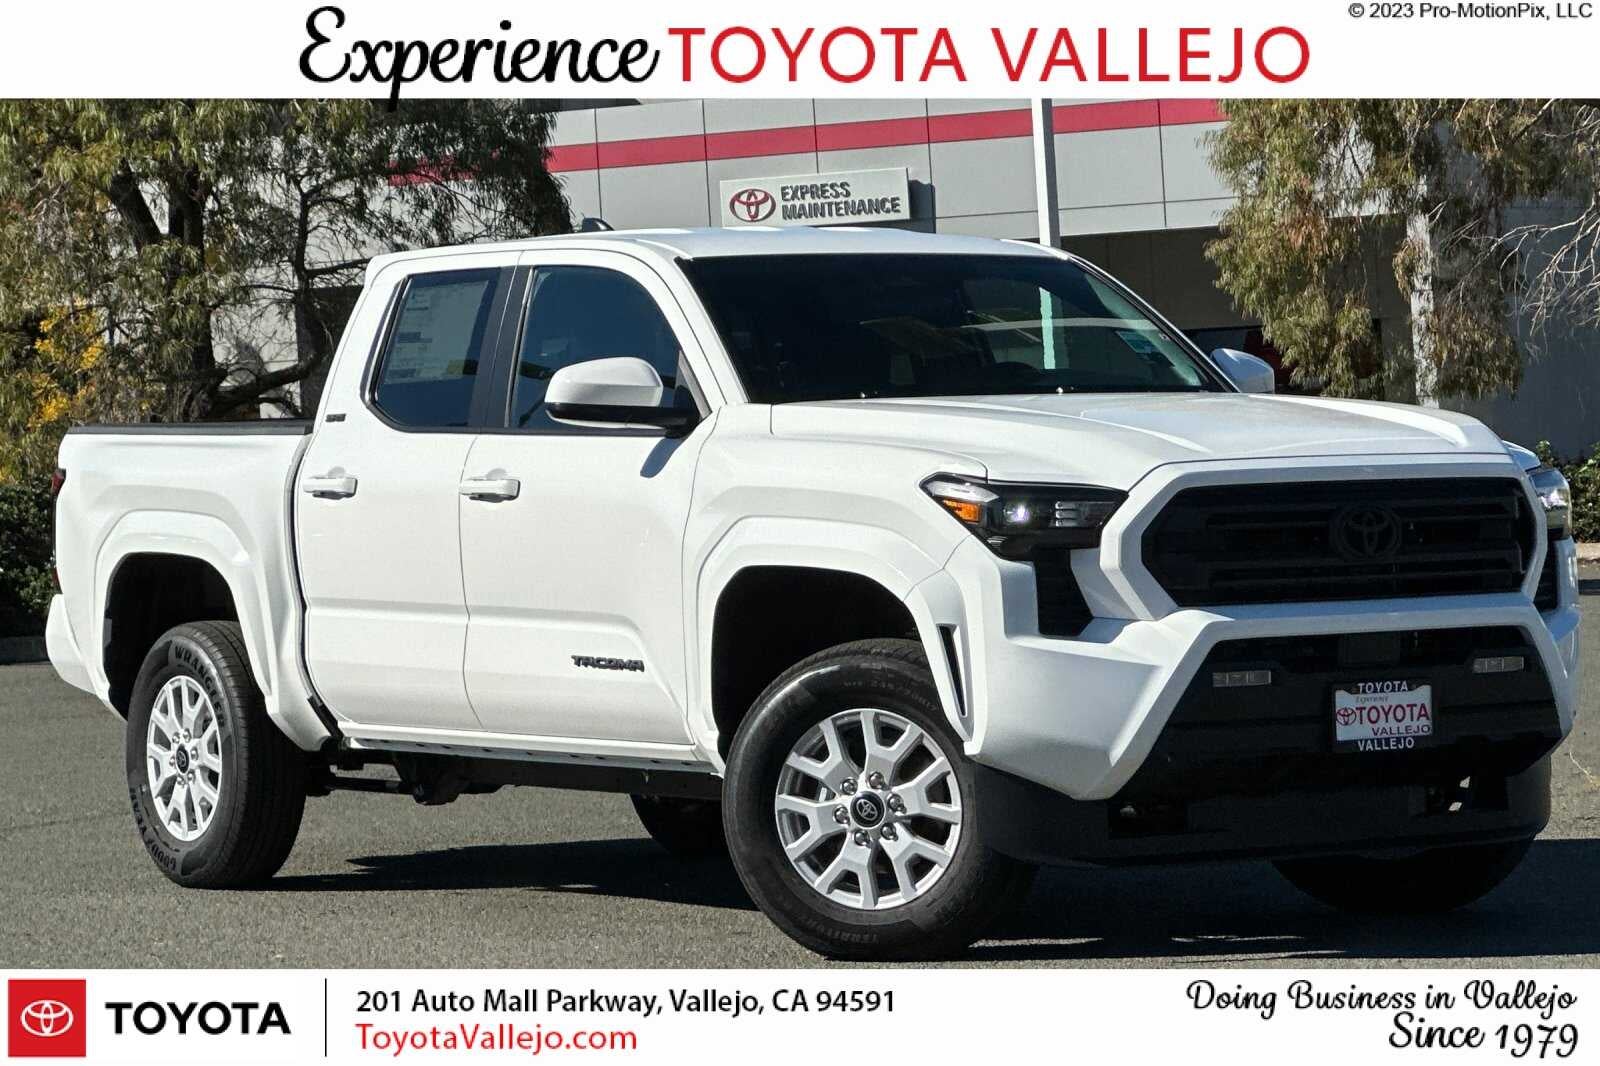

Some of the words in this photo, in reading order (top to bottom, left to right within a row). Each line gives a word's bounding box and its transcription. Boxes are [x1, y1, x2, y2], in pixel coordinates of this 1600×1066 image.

[781, 181, 850, 202] EXPRESS
[782, 197, 901, 221] MAINTENANCE
[173, 645, 226, 729] WRANGLER
[1358, 680, 1409, 694] TOYOTA
[1355, 703, 1430, 725] TOYOTA
[1371, 724, 1432, 737] VALLEJO
[1358, 737, 1415, 752] VALLEJO
